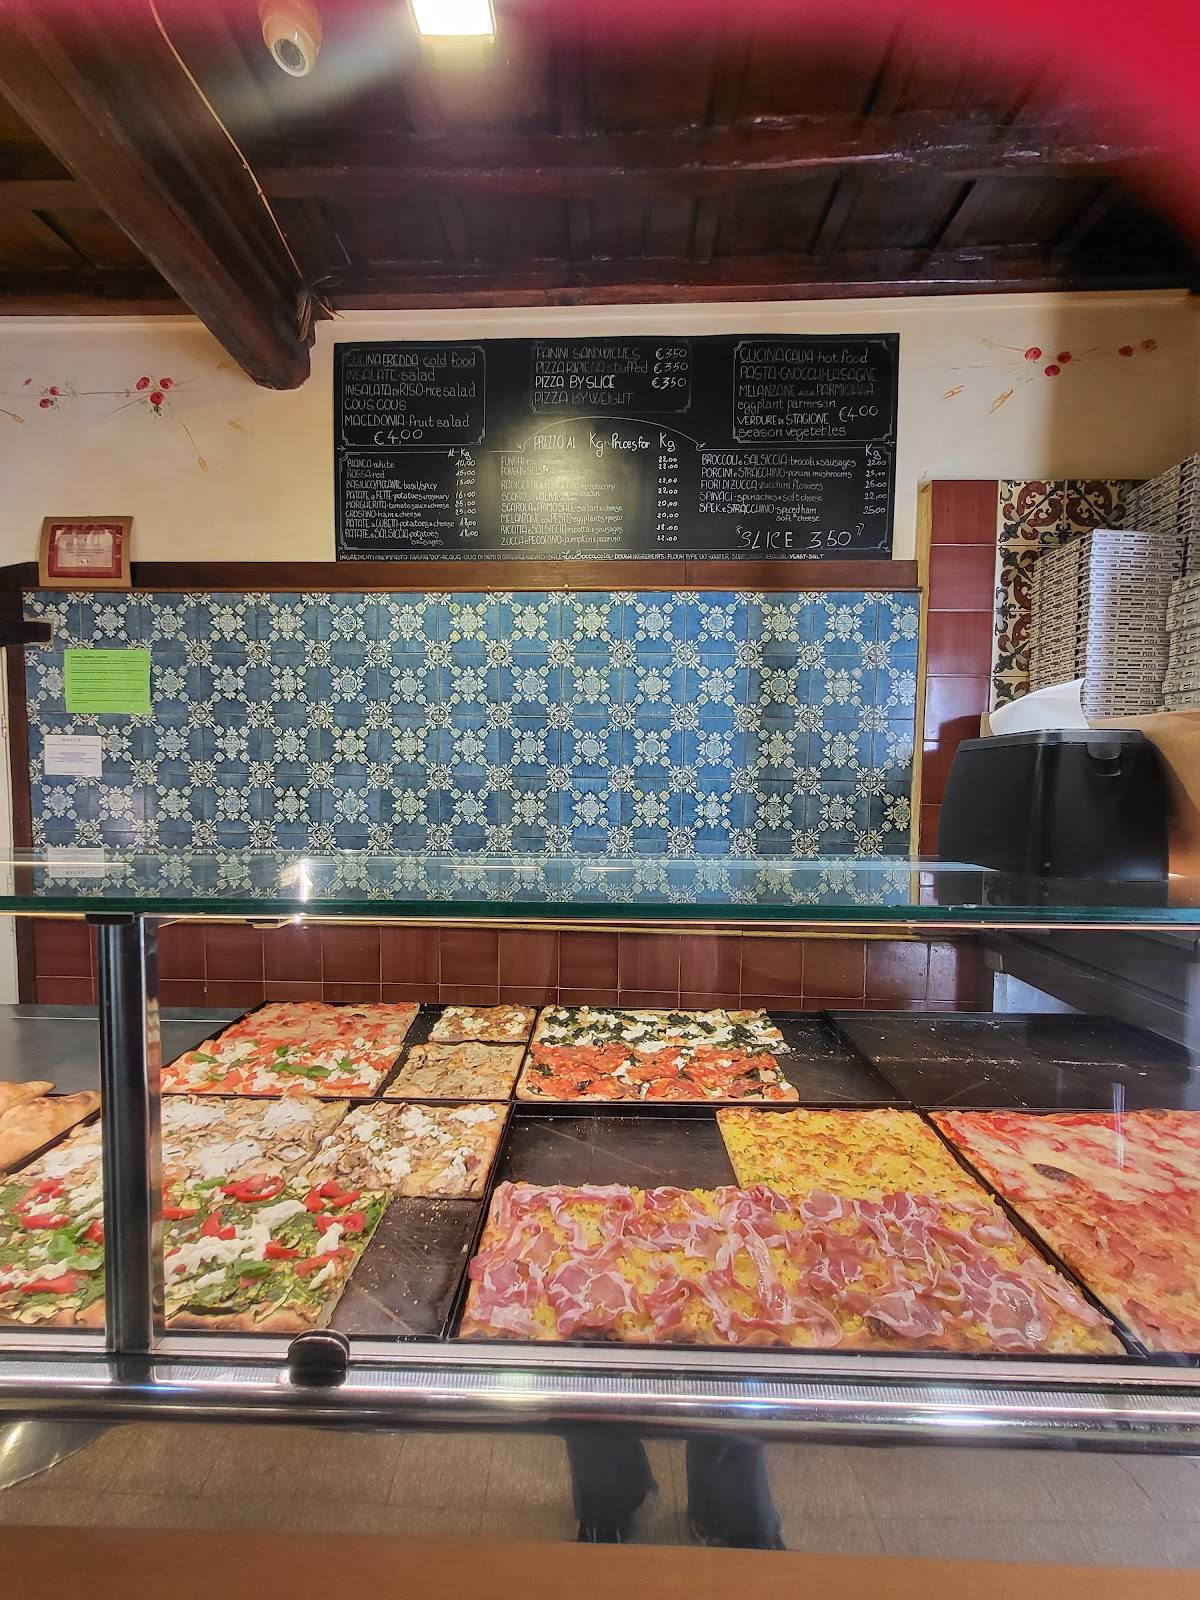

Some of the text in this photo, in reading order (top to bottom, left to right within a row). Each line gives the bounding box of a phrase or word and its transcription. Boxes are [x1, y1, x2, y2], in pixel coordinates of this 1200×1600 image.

[452, 352, 476, 366] food
[573, 347, 640, 360] SANDWICHES
[536, 360, 564, 374] PIZZA
[740, 366, 776, 380] PASTA
[827, 368, 878, 381] LASAGNE
[400, 368, 436, 381] salad
[535, 375, 564, 388] PIZZA
[570, 375, 584, 390] BY
[586, 374, 615, 389] SLICE
[345, 383, 391, 396] INSALATA
[400, 382, 424, 396] RISO
[443, 381, 476, 397] salad
[534, 391, 568, 404] PIZZA
[344, 399, 407, 411] COUS COUS
[738, 399, 783, 414] eggplant
[344, 413, 470, 427] MACEDONIA fruit salad
[737, 415, 777, 425] VERDURE
[786, 413, 829, 425] STAGIONE
[738, 428, 783, 437] season
[533, 430, 676, 457] PREZZO Kg Prices for Kg
[461, 448, 471, 460] Kg
[865, 443, 881, 460] Kg
[702, 453, 738, 465] BROCCOLI
[743, 454, 787, 466] SALSICCIA
[819, 460, 856, 470] sausages
[702, 467, 733, 478] PORCINI
[738, 467, 785, 478] STRACCHINO
[813, 470, 852, 479] mushrooms
[700, 480, 720, 489] FIORI
[730, 480, 757, 490] ZUCCA
[346, 490, 370, 499] PATATE
[376, 490, 392, 500] FETTE
[700, 491, 732, 502] SPINACI
[782, 492, 800, 501] soft
[502, 502, 532, 512] SCAROLA
[699, 502, 722, 512] SPEK
[727, 504, 774, 515] STRACCHINO
[801, 504, 817, 514] ham
[346, 519, 370, 528] PATATE
[501, 524, 528, 534] RICOTTA
[532, 524, 566, 535] SALSICCIA
[345, 529, 370, 538] PATATE
